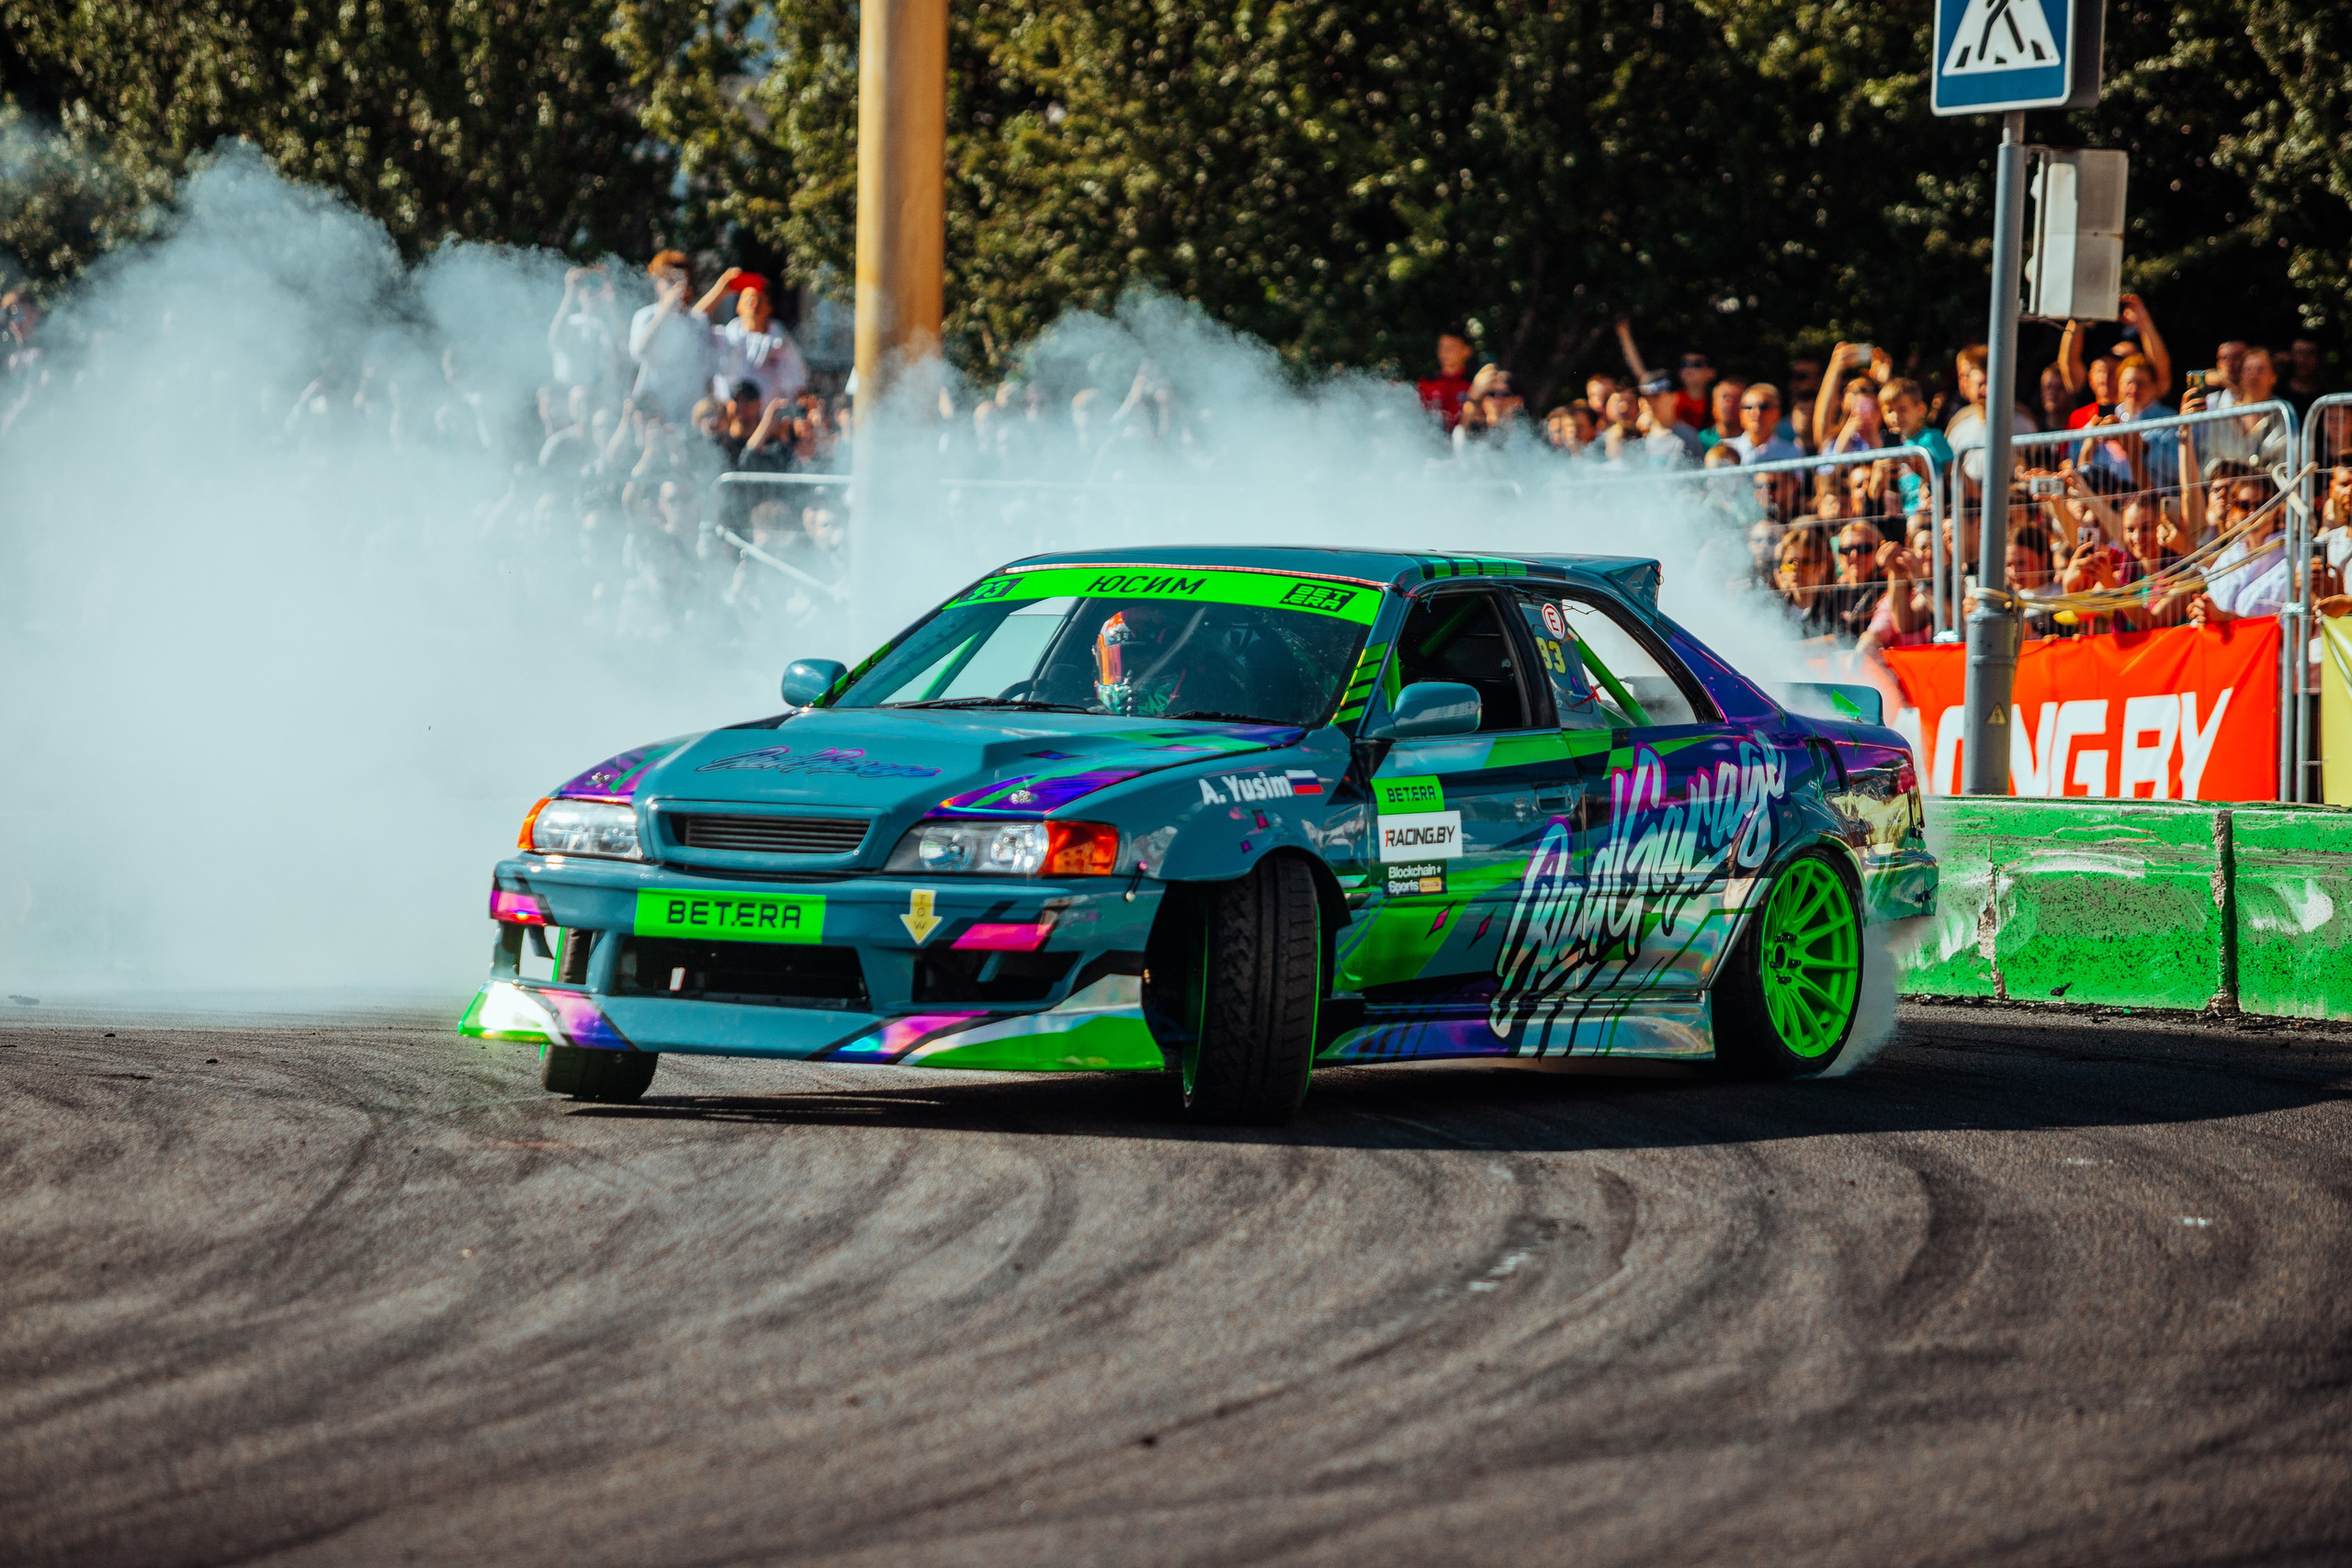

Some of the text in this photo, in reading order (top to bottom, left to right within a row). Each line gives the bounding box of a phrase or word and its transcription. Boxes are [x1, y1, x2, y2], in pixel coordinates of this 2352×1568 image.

[967, 581, 1011, 601] 93
[1085, 575, 1208, 595] ЮСИМ
[1295, 585, 1351, 601] BET
[1547, 611, 1560, 632] E
[1198, 772, 1294, 806] A. Yusim
[1388, 864, 1437, 879] Blockchain
[1388, 879, 1419, 896] Sports
[913, 894, 928, 931] TOW
